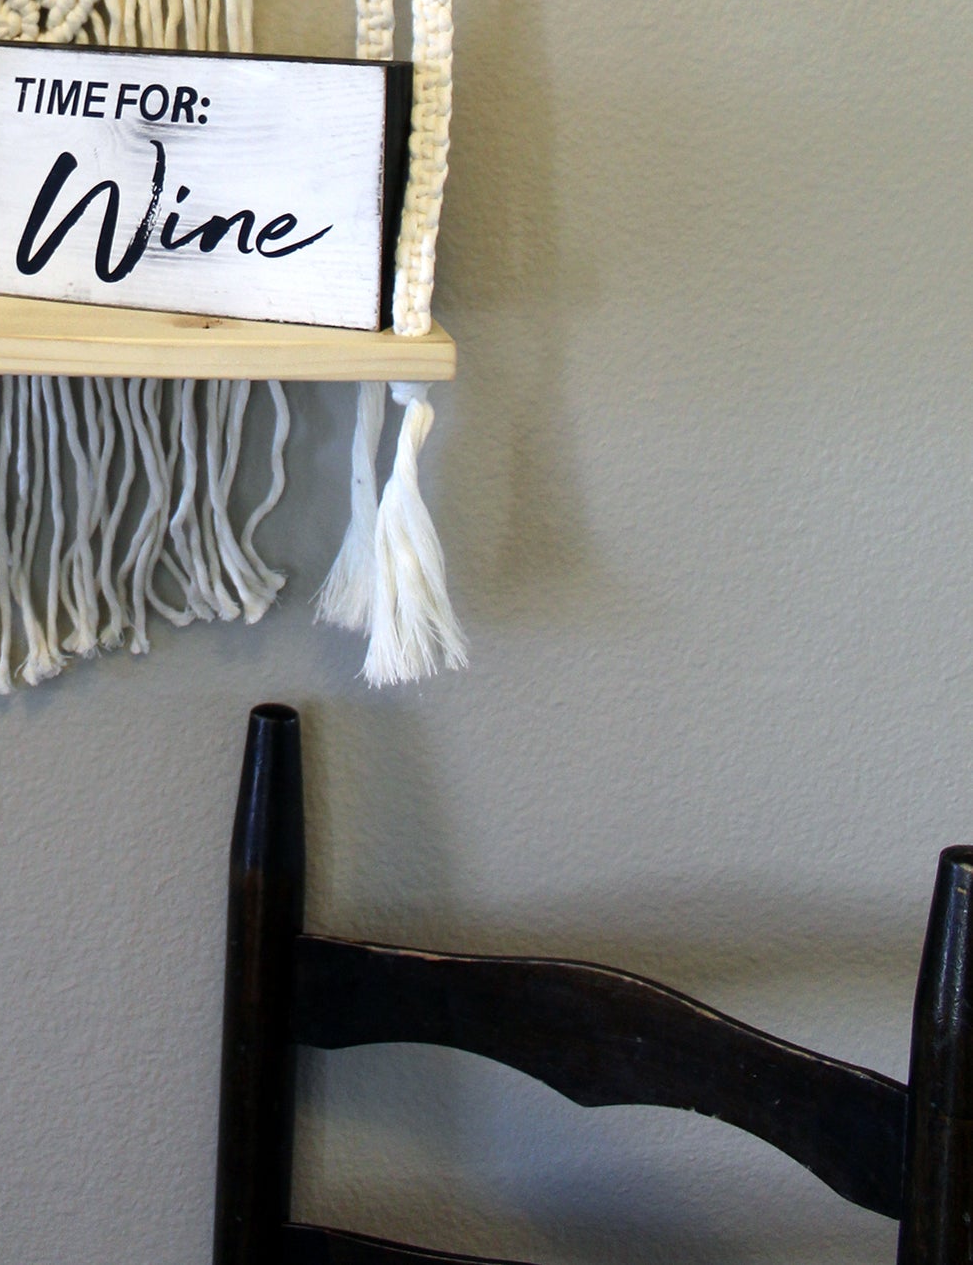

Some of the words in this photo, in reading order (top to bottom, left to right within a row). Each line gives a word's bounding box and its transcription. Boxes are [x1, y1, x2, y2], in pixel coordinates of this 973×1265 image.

[15, 77, 109, 119] TIME
[115, 84, 211, 125] FOR:
[16, 140, 333, 283] Wine
